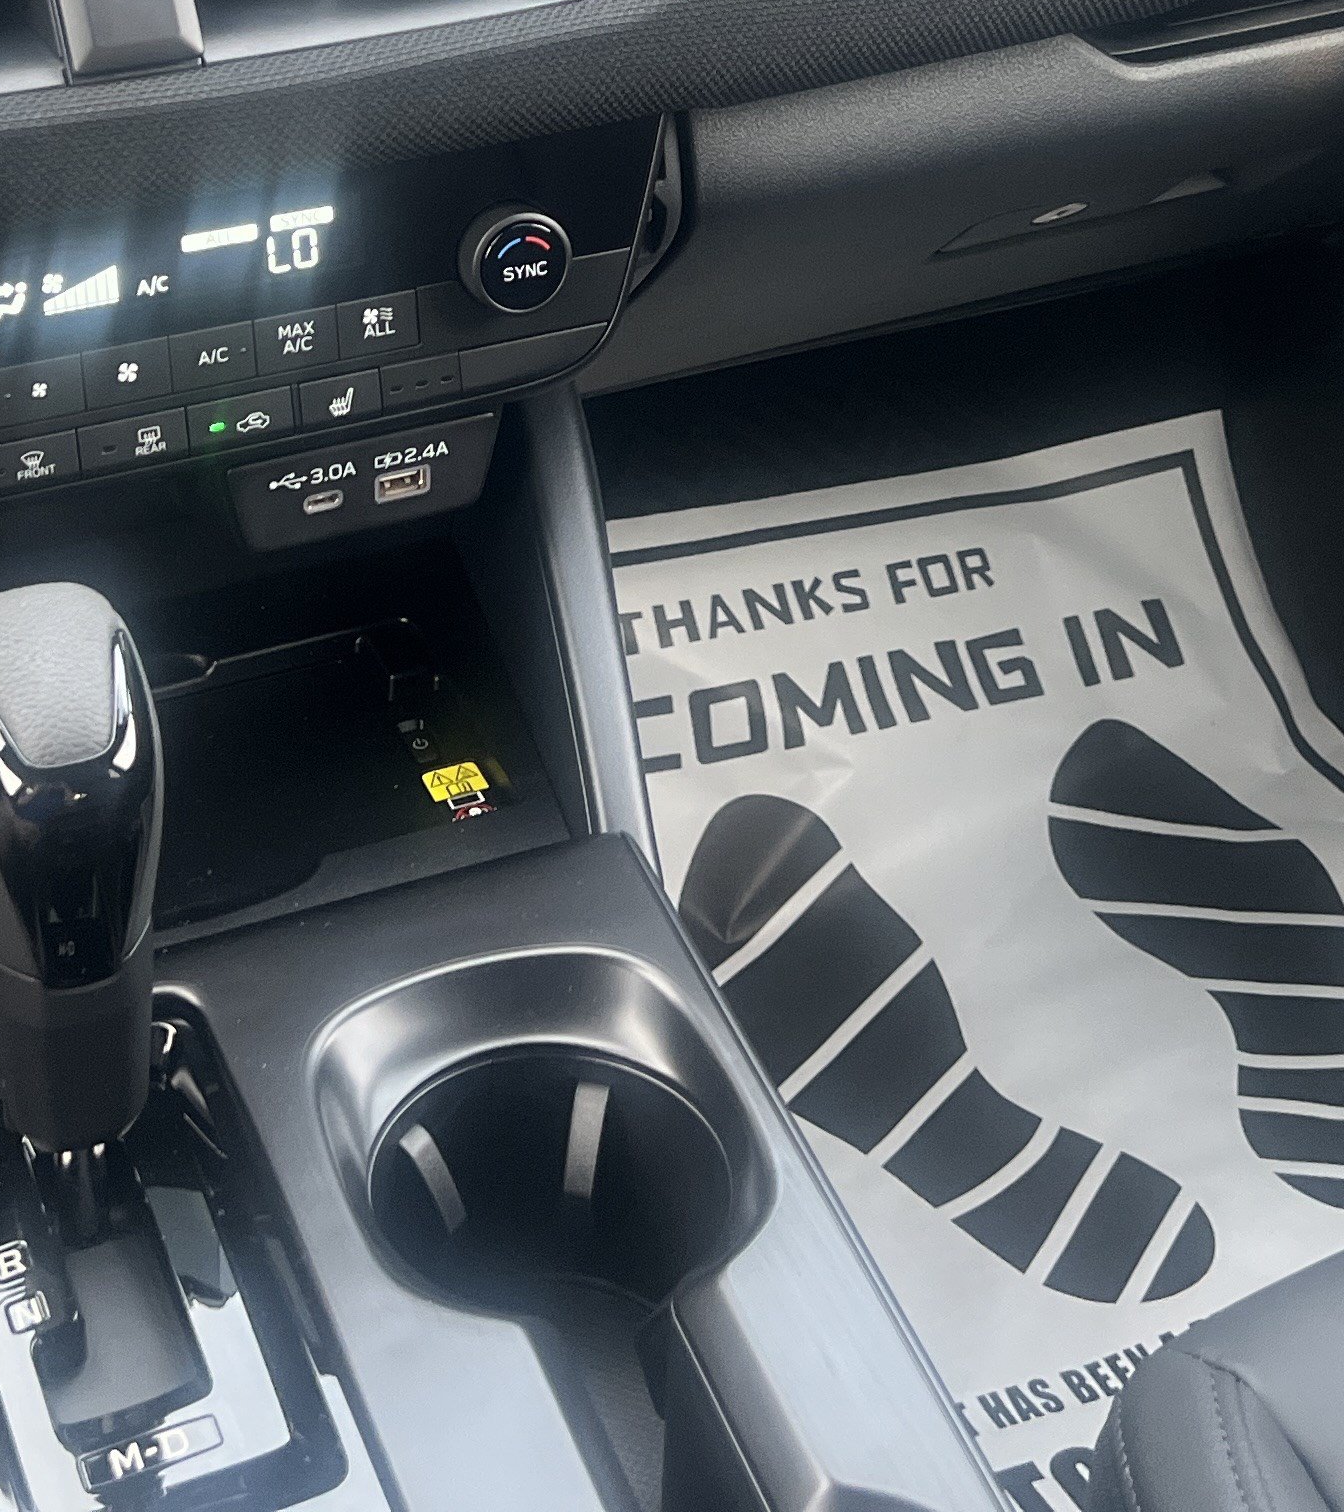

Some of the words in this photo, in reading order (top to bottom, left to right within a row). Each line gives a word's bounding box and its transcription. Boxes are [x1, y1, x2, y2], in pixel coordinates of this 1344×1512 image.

[266, 227, 319, 274] LO
[503, 260, 548, 282] SYNC
[136, 275, 169, 297] A/C
[277, 320, 315, 340] MAX
[364, 320, 396, 339] ALL
[198, 346, 230, 366] A/C
[282, 336, 315, 356] A/C
[134, 441, 167, 457] REAR
[403, 440, 449, 464] 2.4A
[17, 463, 56, 481] FRONT
[309, 461, 357, 485] 3.0A
[618, 568, 871, 656] THANKS
[886, 547, 995, 606] FOR
[1063, 597, 1185, 688] IN
[977, 1378, 1065, 1429] HAS
